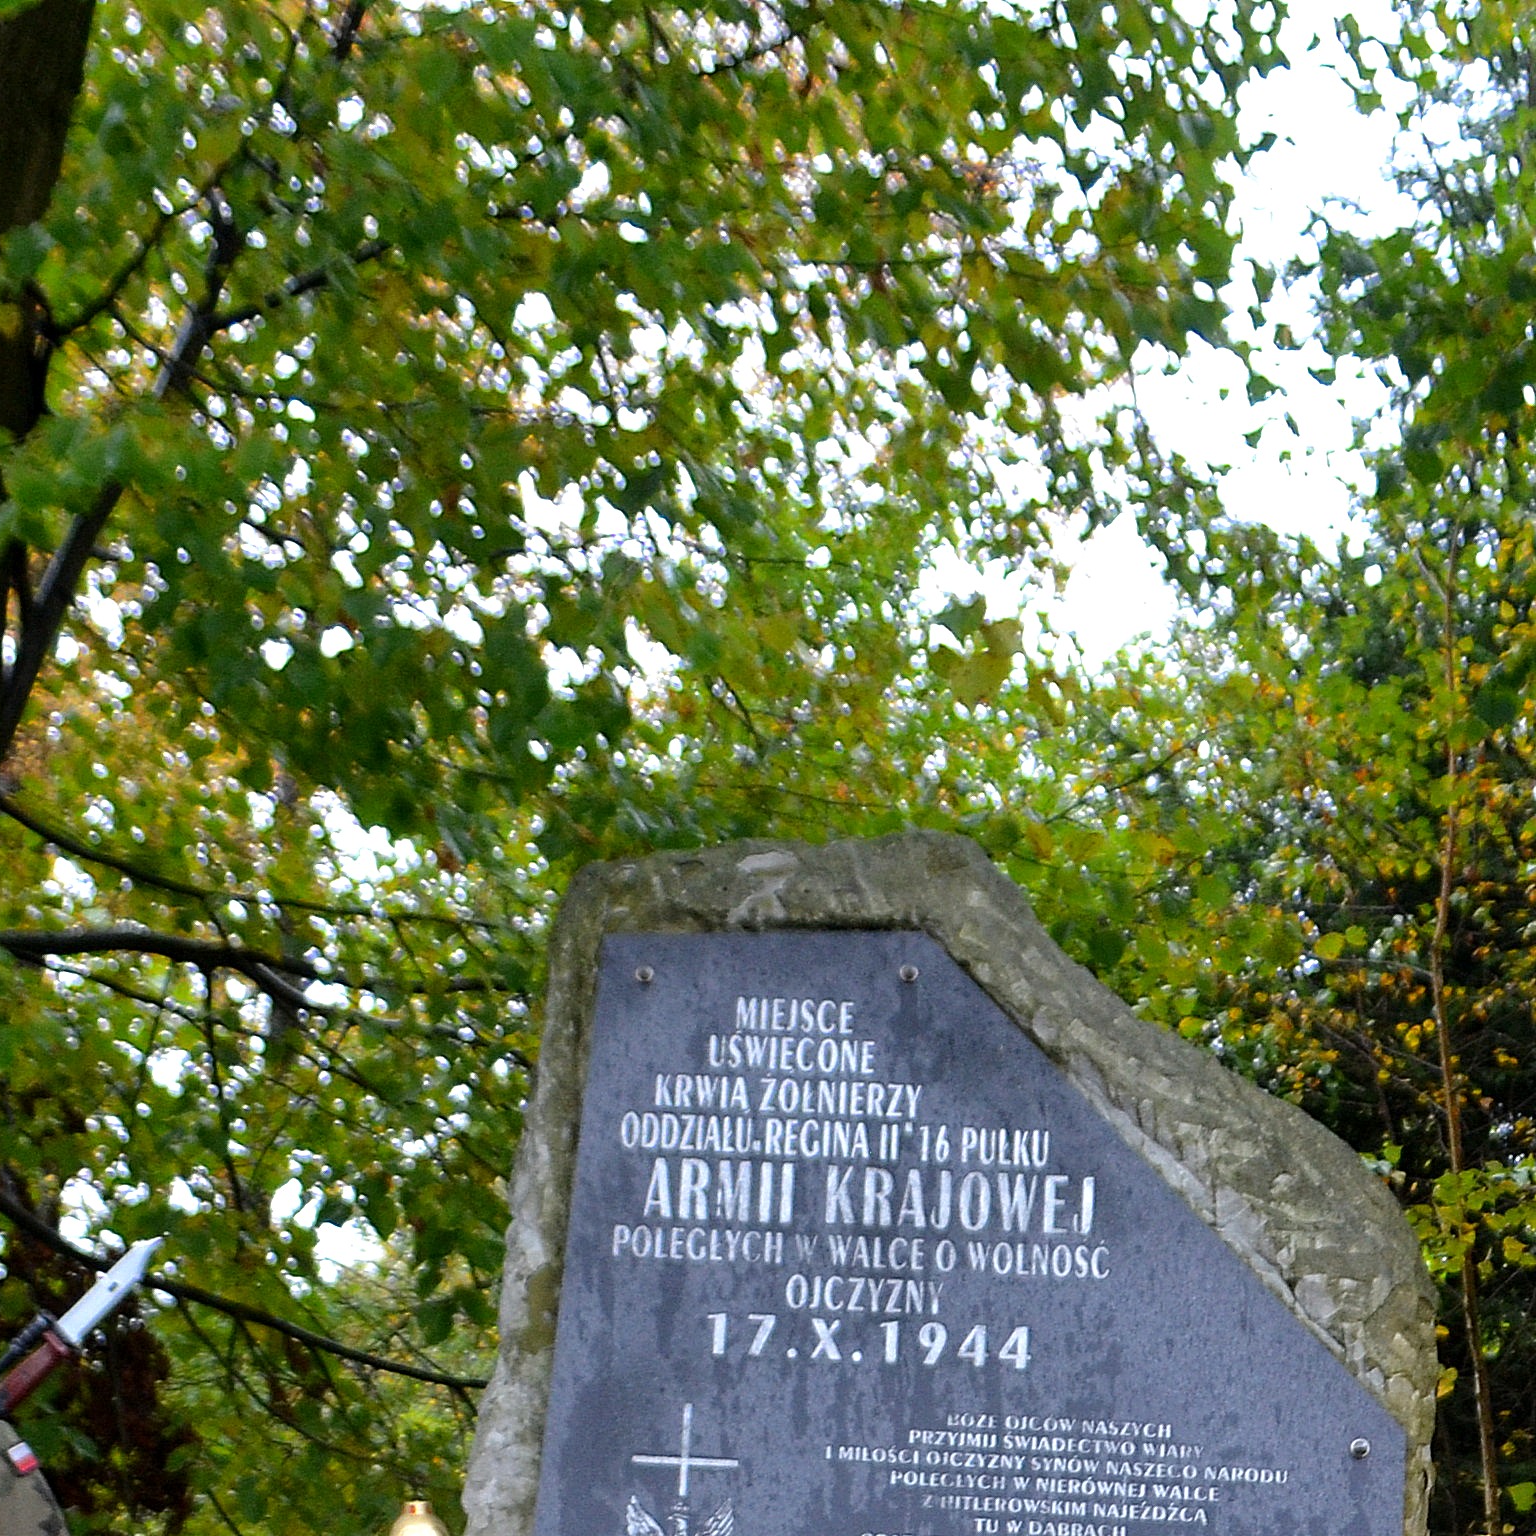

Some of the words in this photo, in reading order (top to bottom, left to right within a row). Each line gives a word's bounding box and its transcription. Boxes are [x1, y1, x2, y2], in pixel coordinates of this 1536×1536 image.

[735, 997, 855, 1034] MIEJSCE
[708, 1031, 876, 1074] UŚWIĘCONE
[654, 1073, 751, 1113] KRWIĄ
[759, 1073, 922, 1118] ŻOŁNIERZY
[920, 1125, 950, 1162] 16
[961, 1127, 1049, 1167] PUŁKU
[643, 1157, 795, 1224] ARMII
[824, 1165, 1096, 1235] KRAJOWEJ
[612, 1224, 784, 1264] POLEGŁYCH
[795, 1233, 819, 1264] W
[828, 1234, 925, 1271] WALCE
[935, 1239, 957, 1272] O
[967, 1239, 1111, 1280] WOLNOŚĆ
[785, 1273, 944, 1315] OJCZYZNY
[908, 1429, 997, 1448] PRZYJMIJ
[1004, 1431, 1135, 1456] ŚWIADECTWO
[1143, 1443, 1205, 1459] WIARY
[1005, 1414, 1077, 1433] OJCÓW
[1082, 1419, 1172, 1439] NASZYCH
[825, 1446, 831, 1460] I
[839, 1445, 919, 1464] MIŁOŚCI
[926, 1450, 1026, 1470] OJCZYZNY
[1031, 1455, 1100, 1474] SYNÓW
[1106, 1461, 1197, 1479] NASZEGO
[1204, 1466, 1288, 1484] NARODU
[890, 1470, 1006, 1490] POLEGŁYCH
[1013, 1476, 1031, 1491] W
[1035, 1476, 1146, 1498] NIERÓWNEJ
[1153, 1483, 1221, 1502] WALCE
[974, 1518, 998, 1534] TU
[1007, 1520, 1024, 1534] W
